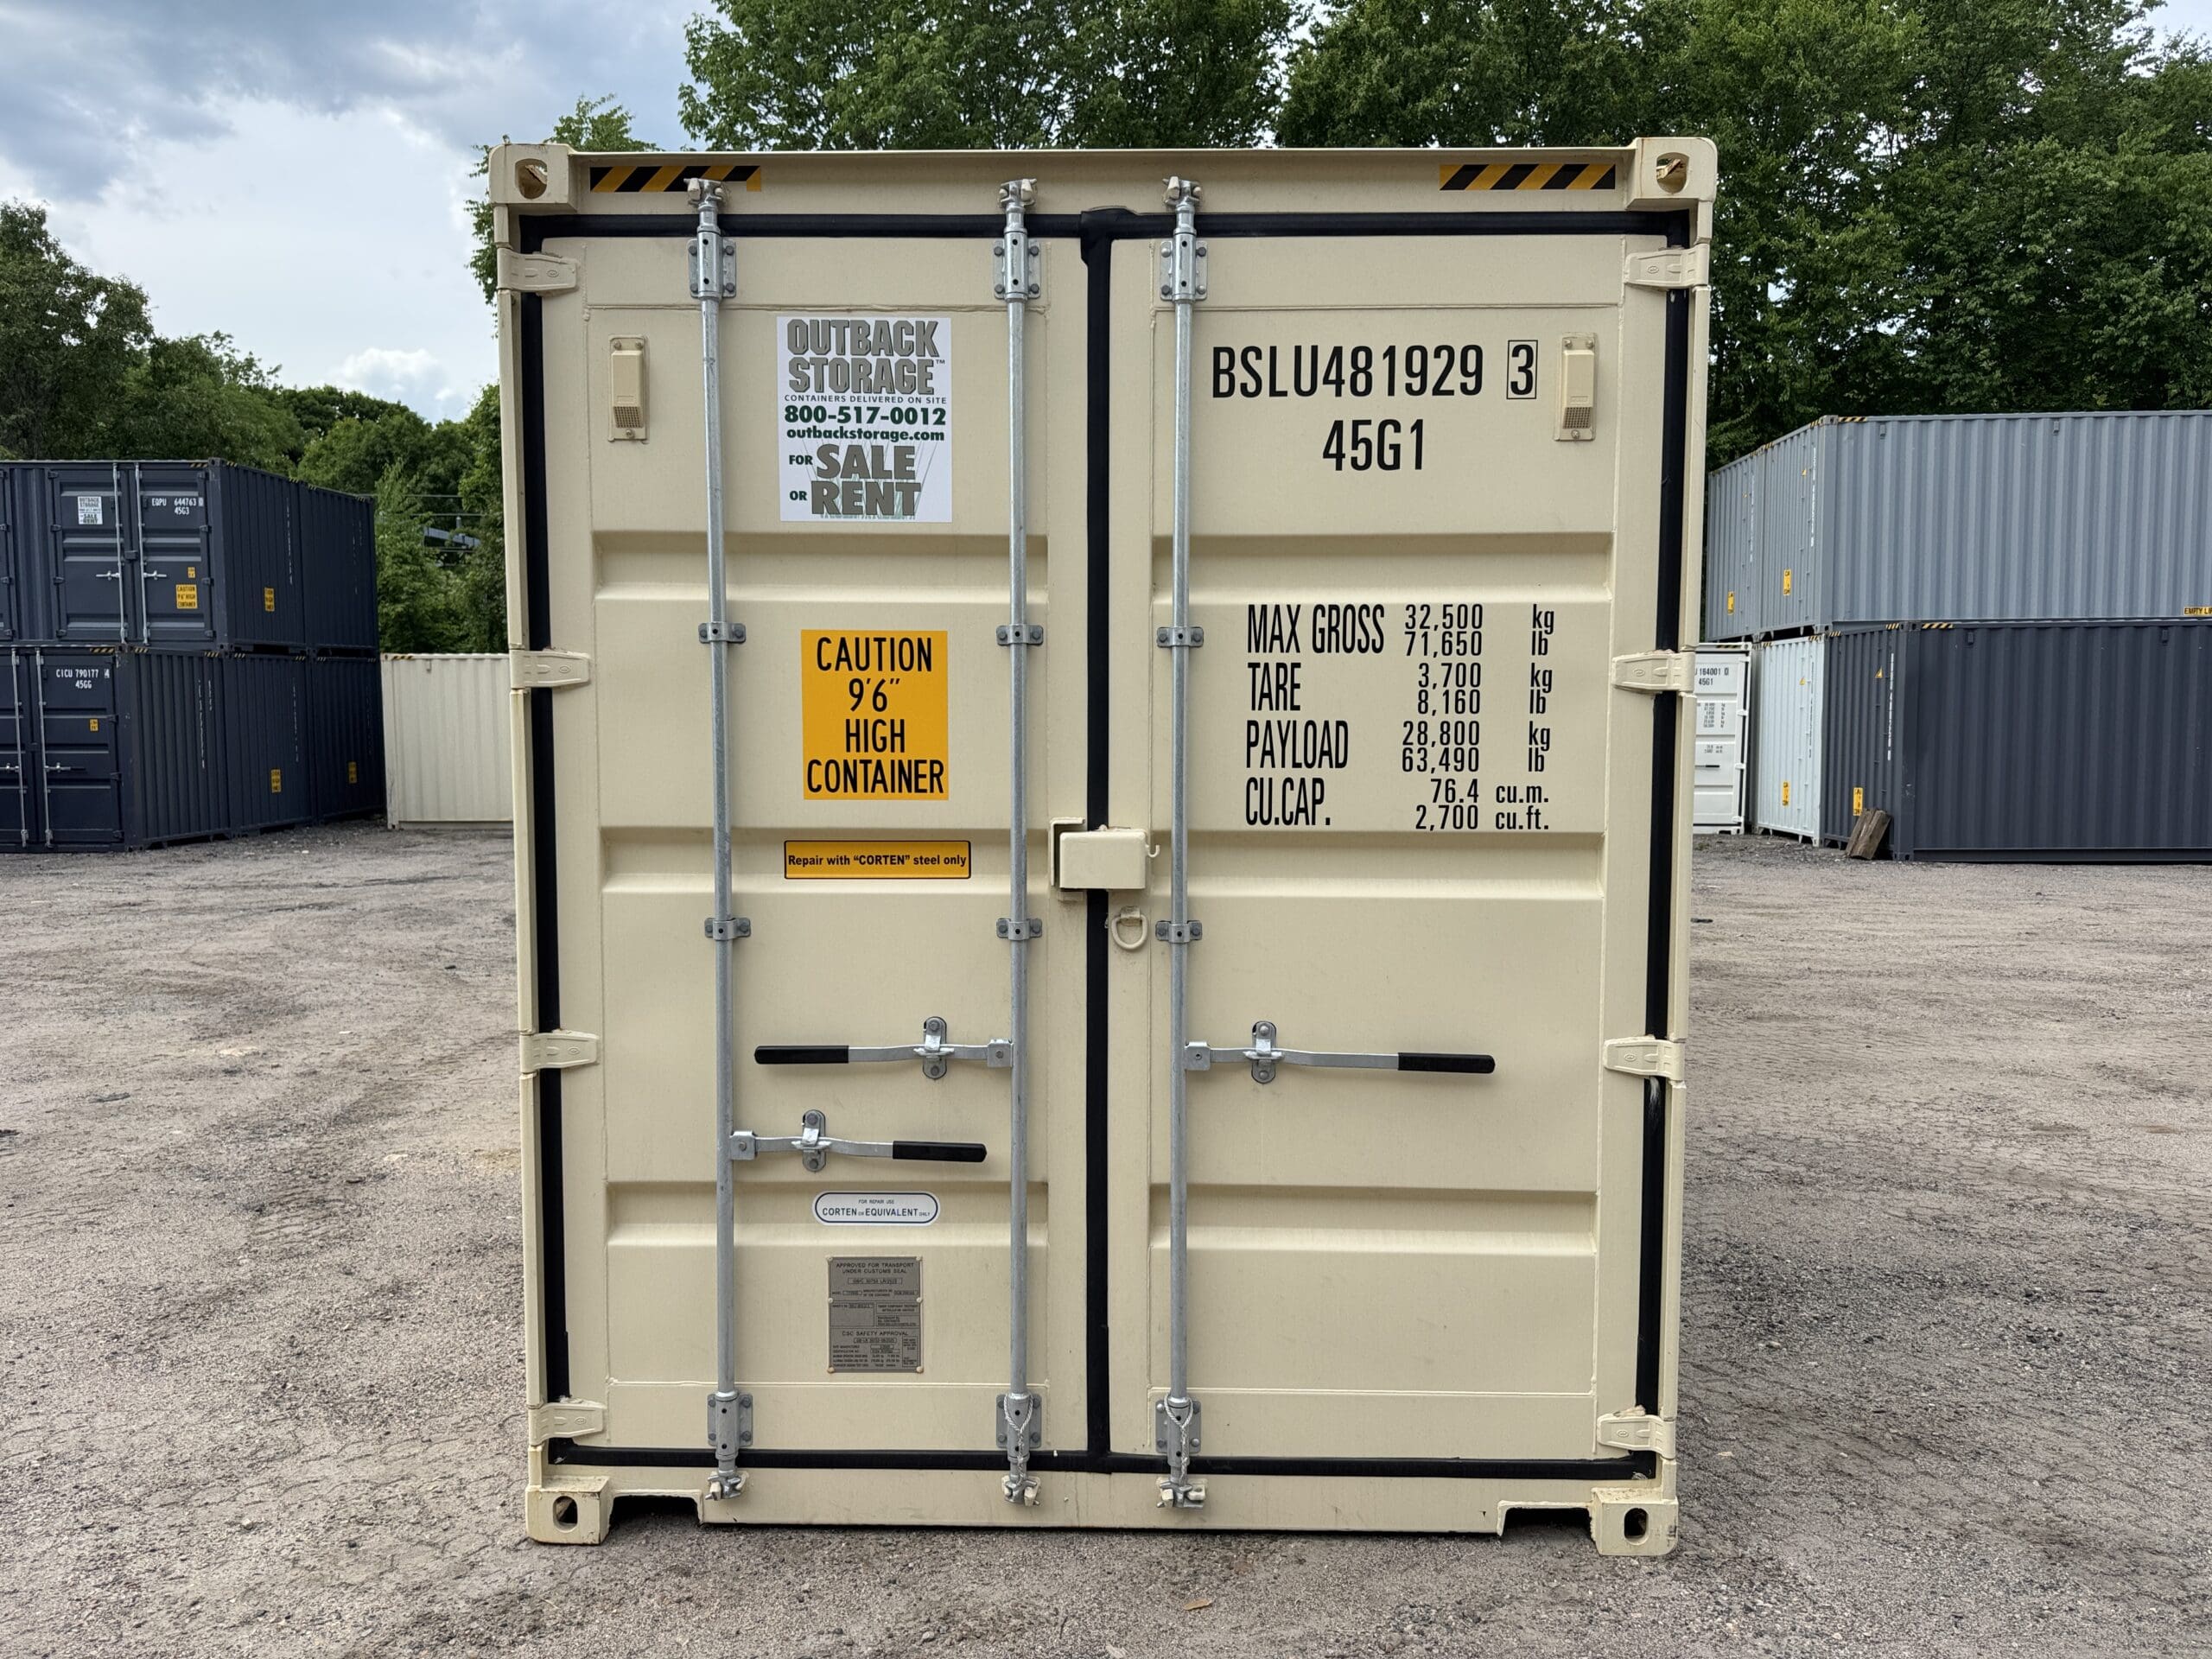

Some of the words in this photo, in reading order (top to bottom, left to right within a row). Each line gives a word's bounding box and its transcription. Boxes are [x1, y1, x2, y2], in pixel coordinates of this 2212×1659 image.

[787, 319, 939, 357] OUTBACK
[788, 357, 935, 395] STORAGE
[1212, 345, 1484, 398] BSLU481929
[1510, 344, 1535, 396] 3
[785, 405, 946, 425] 800-517-0012
[849, 395, 904, 404] DELIVERED
[907, 396, 922, 404] ON
[786, 425, 944, 442] outbackstorage.com
[1322, 418, 1424, 472] 45G1
[789, 454, 813, 466] FOR
[816, 443, 916, 480] SALE
[789, 490, 807, 501] OR
[810, 480, 921, 516] RENT
[1247, 604, 1301, 653] MAX
[1312, 604, 1384, 653] GROSS
[1404, 604, 1484, 632] 32,500
[1532, 603, 1555, 635] kg
[1404, 631, 1483, 658] 71,650
[1531, 631, 1548, 656] lb
[817, 637, 932, 671] CAUTION
[1248, 662, 1301, 711] TARE
[1418, 662, 1481, 690] 3,700
[1530, 663, 1553, 693] kg
[1417, 689, 1480, 716] 8,160
[1529, 690, 1546, 714] lb
[845, 718, 906, 753] HIGH
[1246, 720, 1349, 769] PAYLOAD
[1402, 720, 1480, 748] 28,800
[1528, 721, 1551, 752] kg
[807, 759, 944, 793] CONTAINER
[1402, 747, 1479, 774] 63,490
[1528, 747, 1544, 772] lb
[1245, 777, 1331, 826] CU.CAP.
[1430, 778, 1479, 804] 76.4
[1495, 784, 1549, 804] cu.m.
[1415, 804, 1478, 831] 2,700
[1495, 805, 1549, 830] cu.ft.
[788, 855, 823, 867] Repair
[826, 855, 850, 865] with
[913, 855, 941, 865] steel
[944, 855, 967, 868] only
[822, 1207, 857, 1217] CORTEN
[865, 1208, 918, 1217] EQUIVALENT
